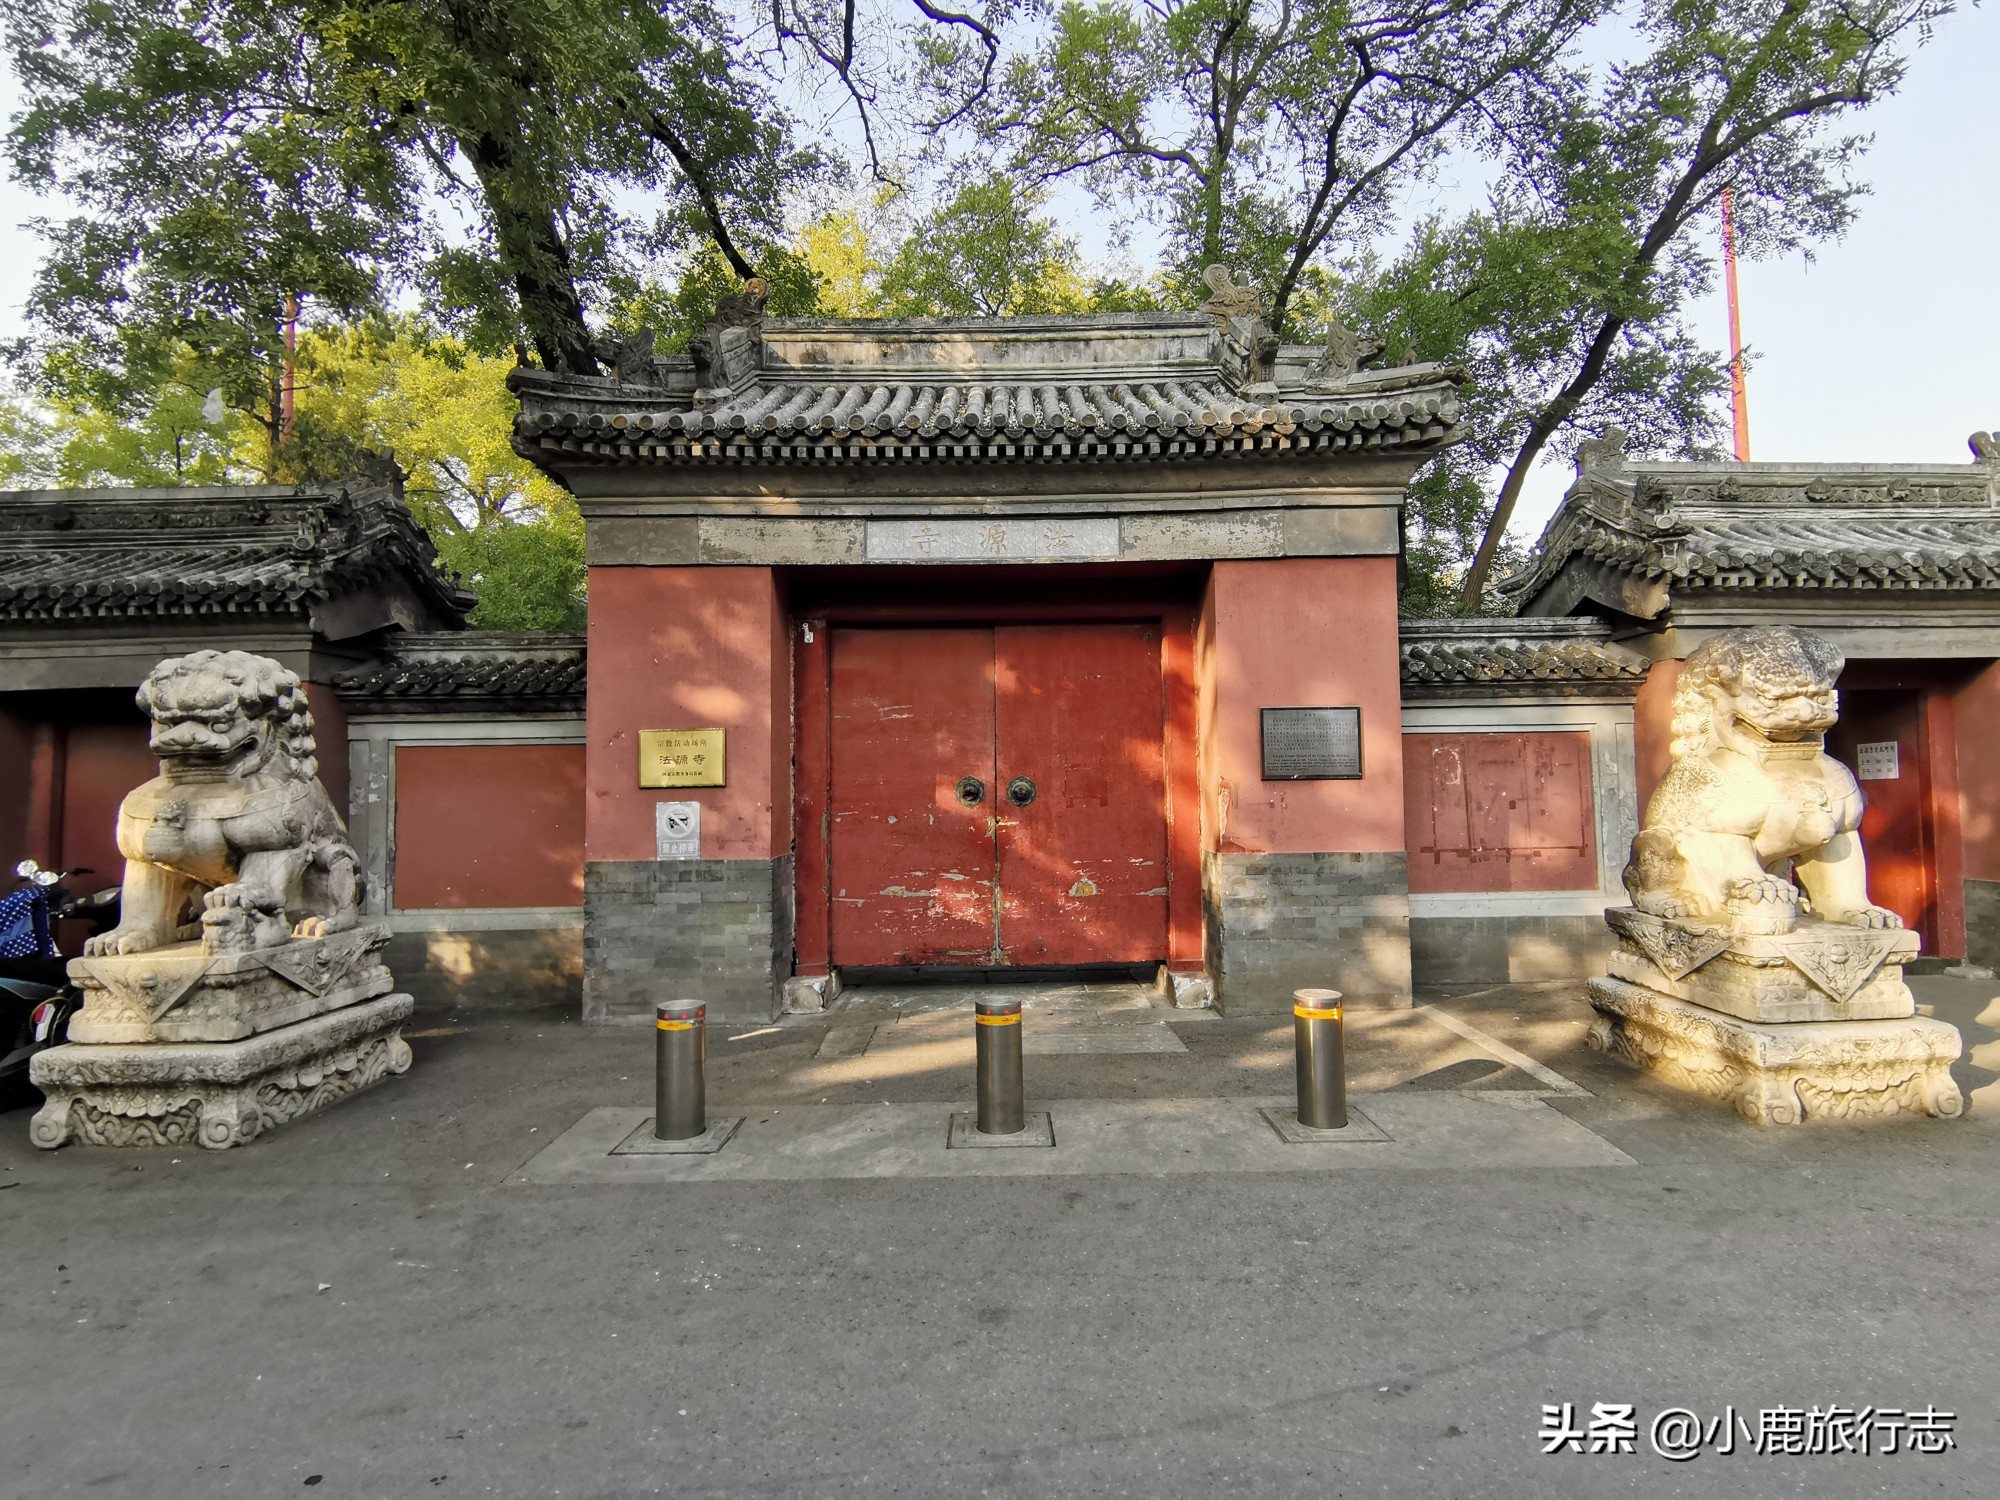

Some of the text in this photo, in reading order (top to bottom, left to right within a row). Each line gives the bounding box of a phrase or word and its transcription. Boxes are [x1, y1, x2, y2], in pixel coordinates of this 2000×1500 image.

[656, 739, 708, 748] 宗教活动场所
[659, 754, 706, 766] 法源寺
[662, 842, 696, 854] 禁止停车
